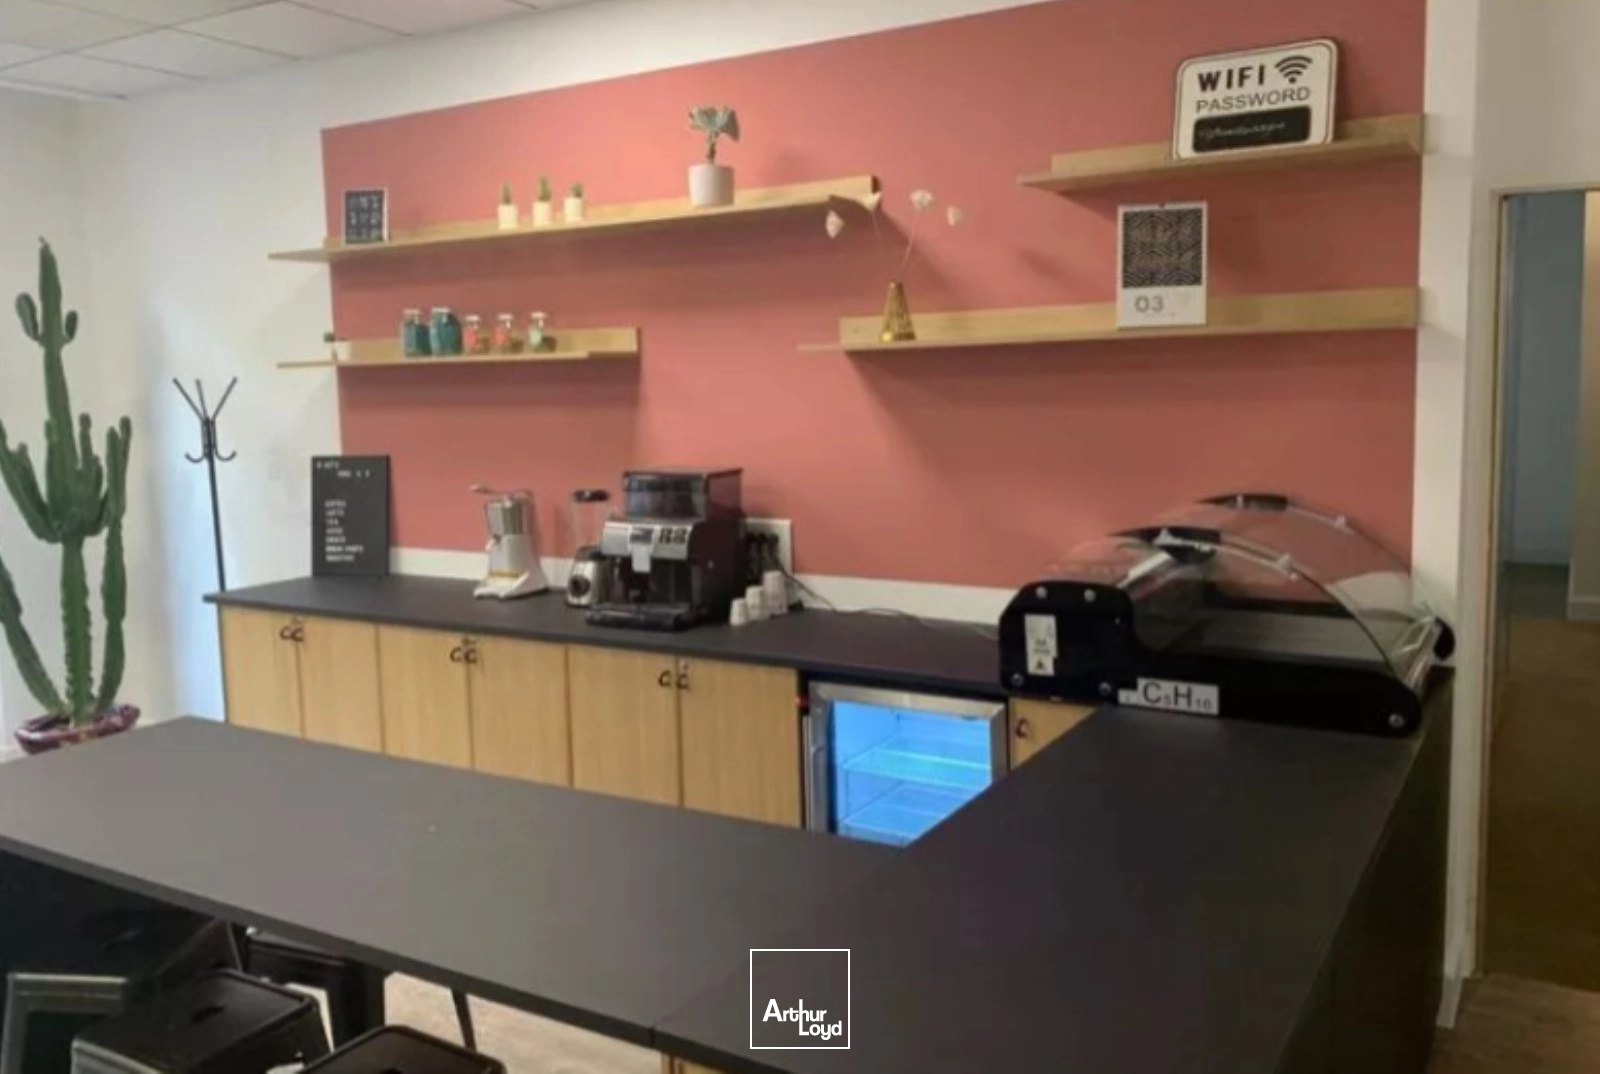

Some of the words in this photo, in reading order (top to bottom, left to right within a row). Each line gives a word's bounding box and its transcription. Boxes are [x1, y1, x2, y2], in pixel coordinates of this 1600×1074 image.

[1198, 64, 1266, 92] WIFI
[1196, 86, 1311, 113] PASSWORD
[1134, 295, 1164, 313] 03
